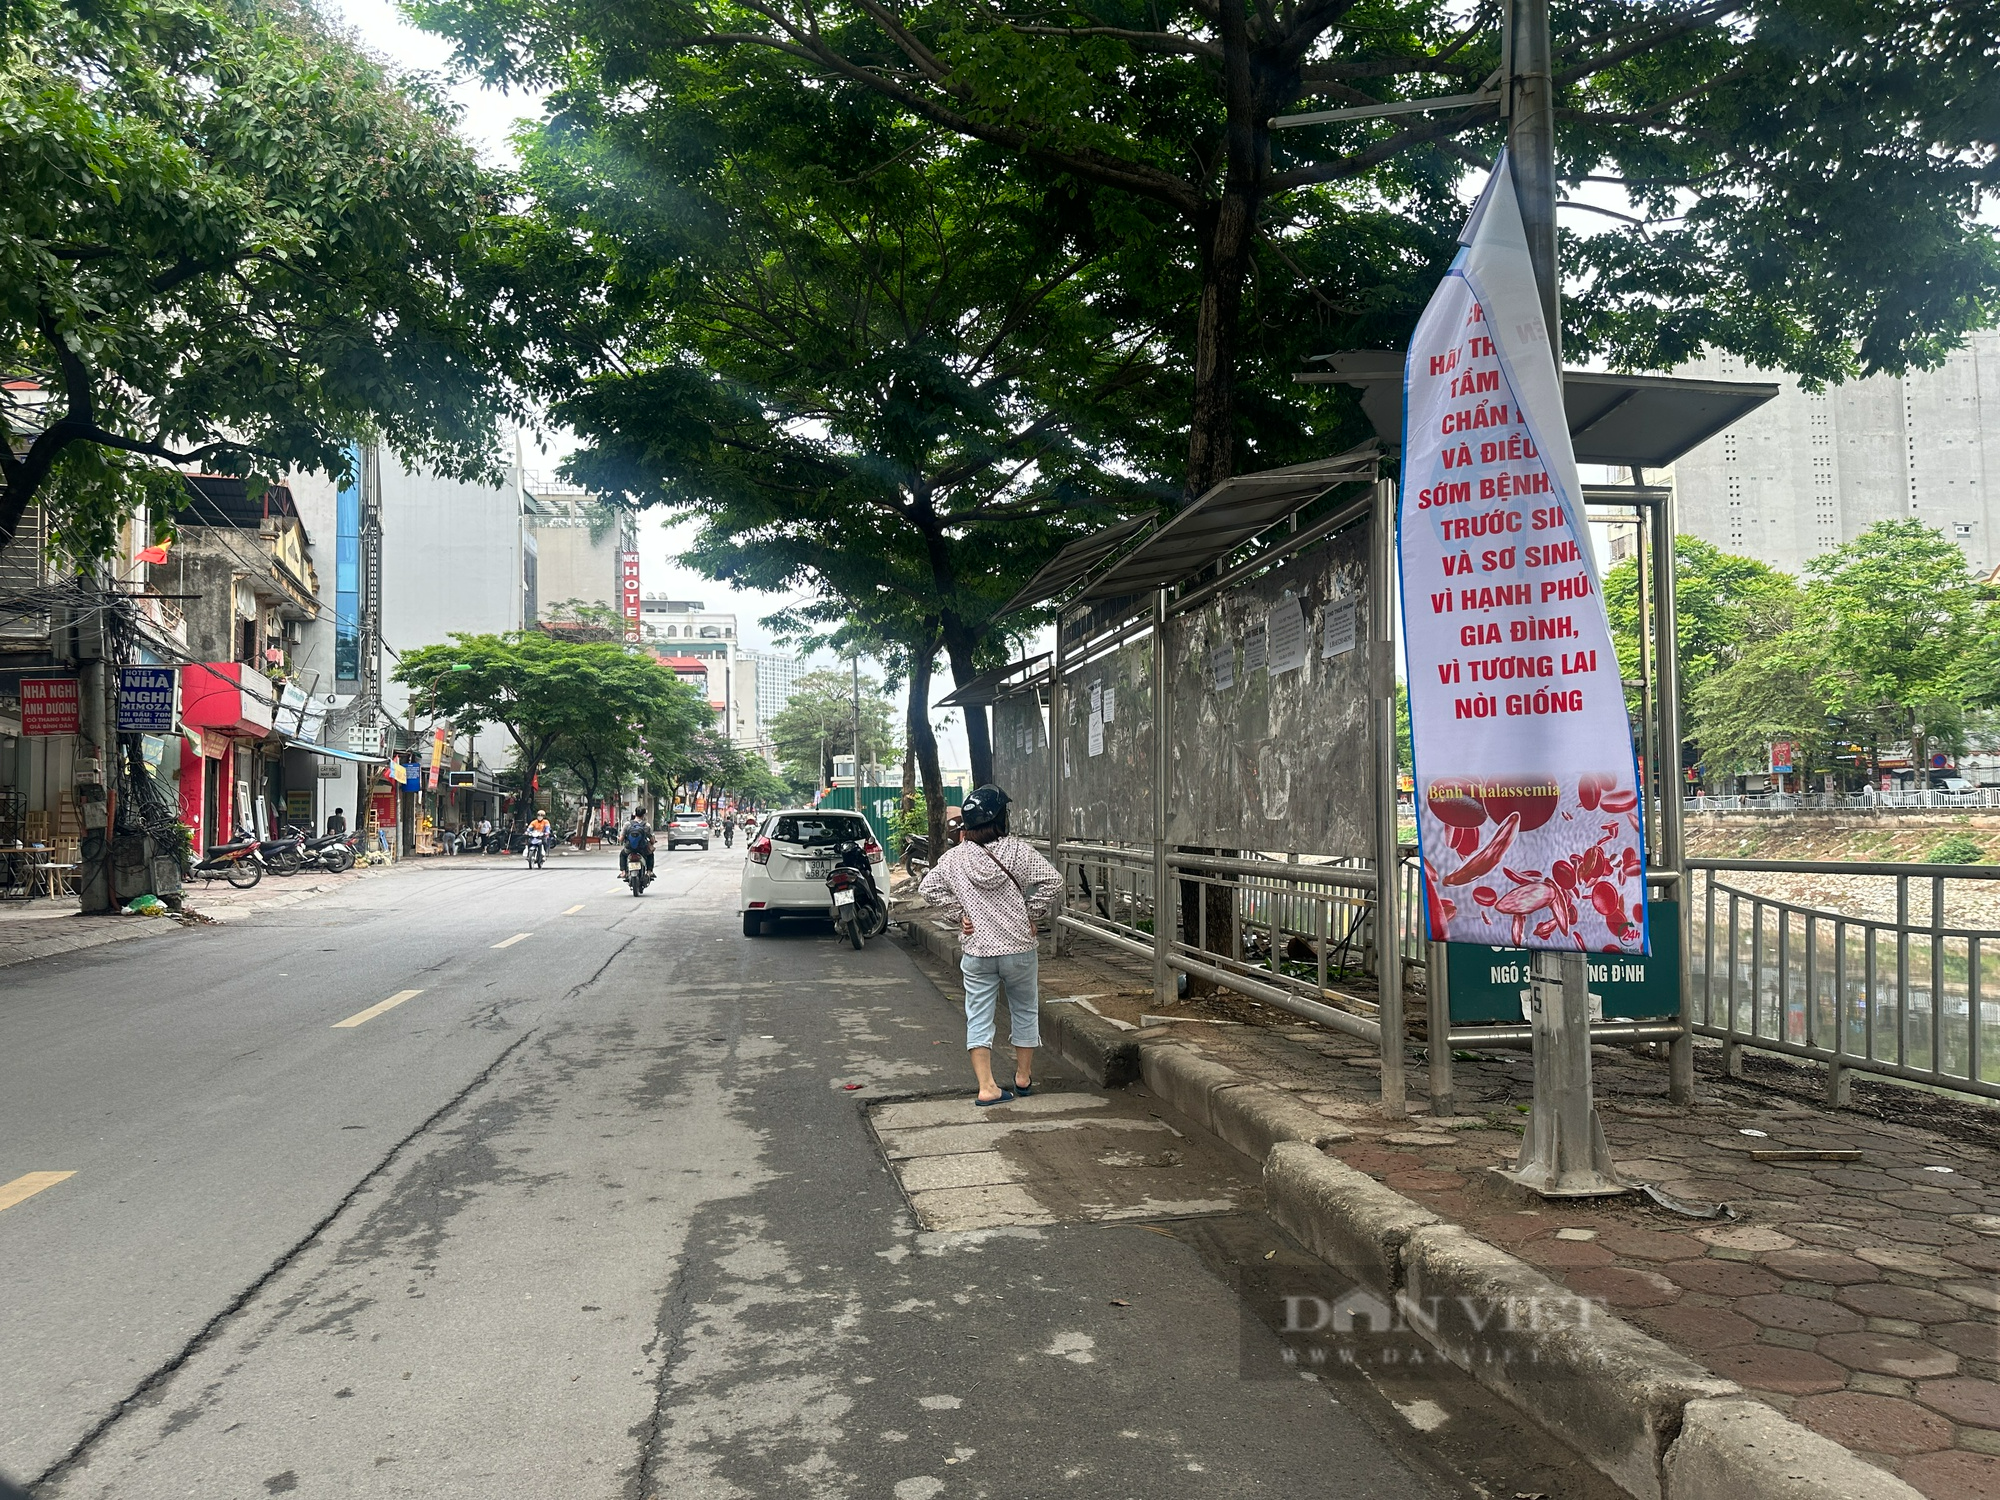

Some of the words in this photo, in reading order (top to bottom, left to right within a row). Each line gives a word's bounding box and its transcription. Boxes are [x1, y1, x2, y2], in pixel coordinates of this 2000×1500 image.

[1450, 367, 1499, 398] TẦM
[1442, 399, 1508, 435] CHẨN
[1442, 441, 1473, 469] VÀ
[1480, 432, 1538, 463] ĐIỀU
[1418, 481, 1471, 510] SỚM
[1440, 511, 1522, 541] TRƯỚC
[623, 554, 639, 563] NICE
[1442, 550, 1473, 577] VÀ
[1481, 545, 1516, 572] SƠ
[1525, 540, 1582, 567] SINH
[1431, 588, 1453, 613] VÌ
[1461, 583, 1532, 613] HẠNH
[1460, 623, 1502, 647] GIA
[1510, 616, 1579, 642] ĐÌNH,
[1438, 659, 1460, 684] VÌ
[1468, 655, 1553, 682] TƯƠNG
[1560, 650, 1597, 675] LAI
[23, 681, 47, 699] NHÀ
[125, 674, 169, 688] NHÀ
[24, 701, 43, 715] ÁNH
[46, 701, 77, 715] DƯƠNG
[120, 688, 172, 704] NGHỈ
[121, 703, 171, 711] MIMOZA
[1455, 692, 1497, 719] NÒI
[1505, 685, 1583, 716] GIỐNG
[1428, 784, 1463, 802] Bệnh
[1467, 781, 1560, 799] Thalassemia
[812, 861, 825, 869] 30A
[1622, 929, 1640, 942] 24h
[1490, 960, 1519, 984] NGÕ
